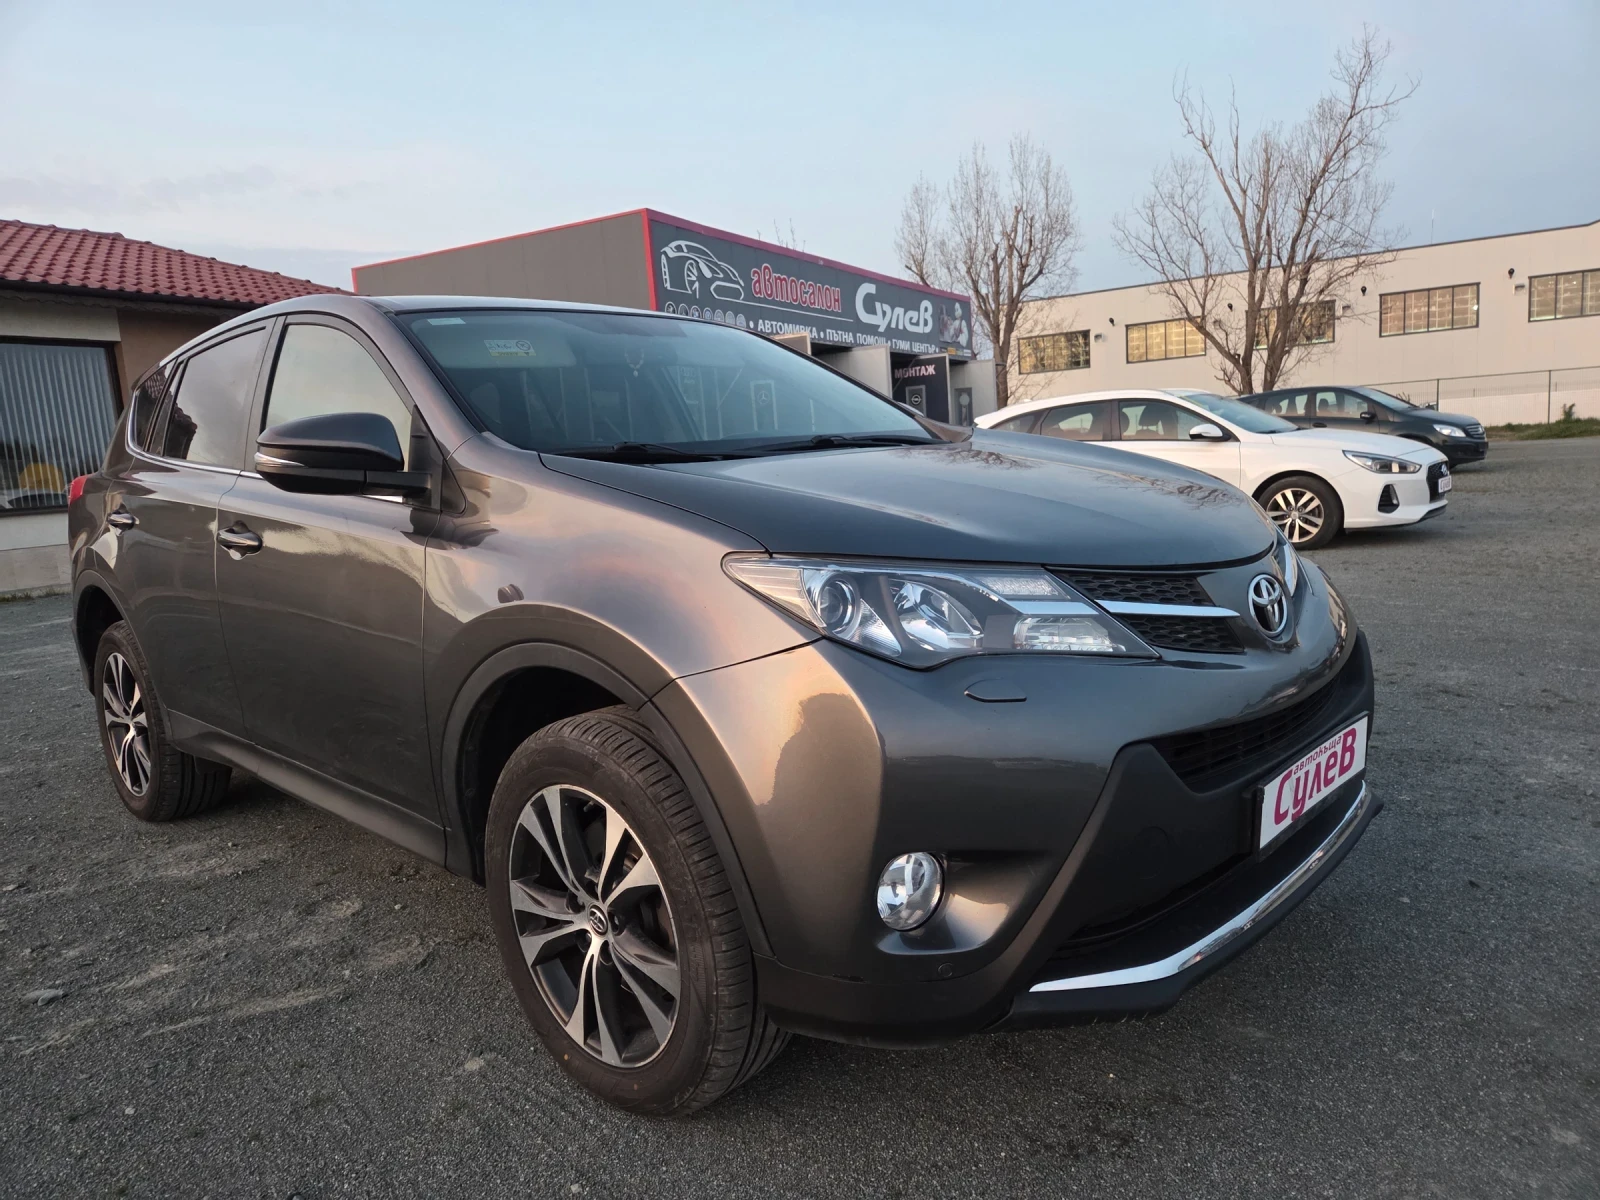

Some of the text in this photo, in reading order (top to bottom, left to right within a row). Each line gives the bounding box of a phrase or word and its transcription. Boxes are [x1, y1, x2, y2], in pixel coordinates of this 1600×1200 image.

[751, 263, 842, 312] автосалон
[826, 328, 855, 344] ПЪТНА
[892, 338, 911, 351] ГУМИ
[912, 341, 936, 354] ЦЕНТЪР
[894, 364, 936, 379] МОНТАЖ
[1293, 735, 1342, 775] автокъща
